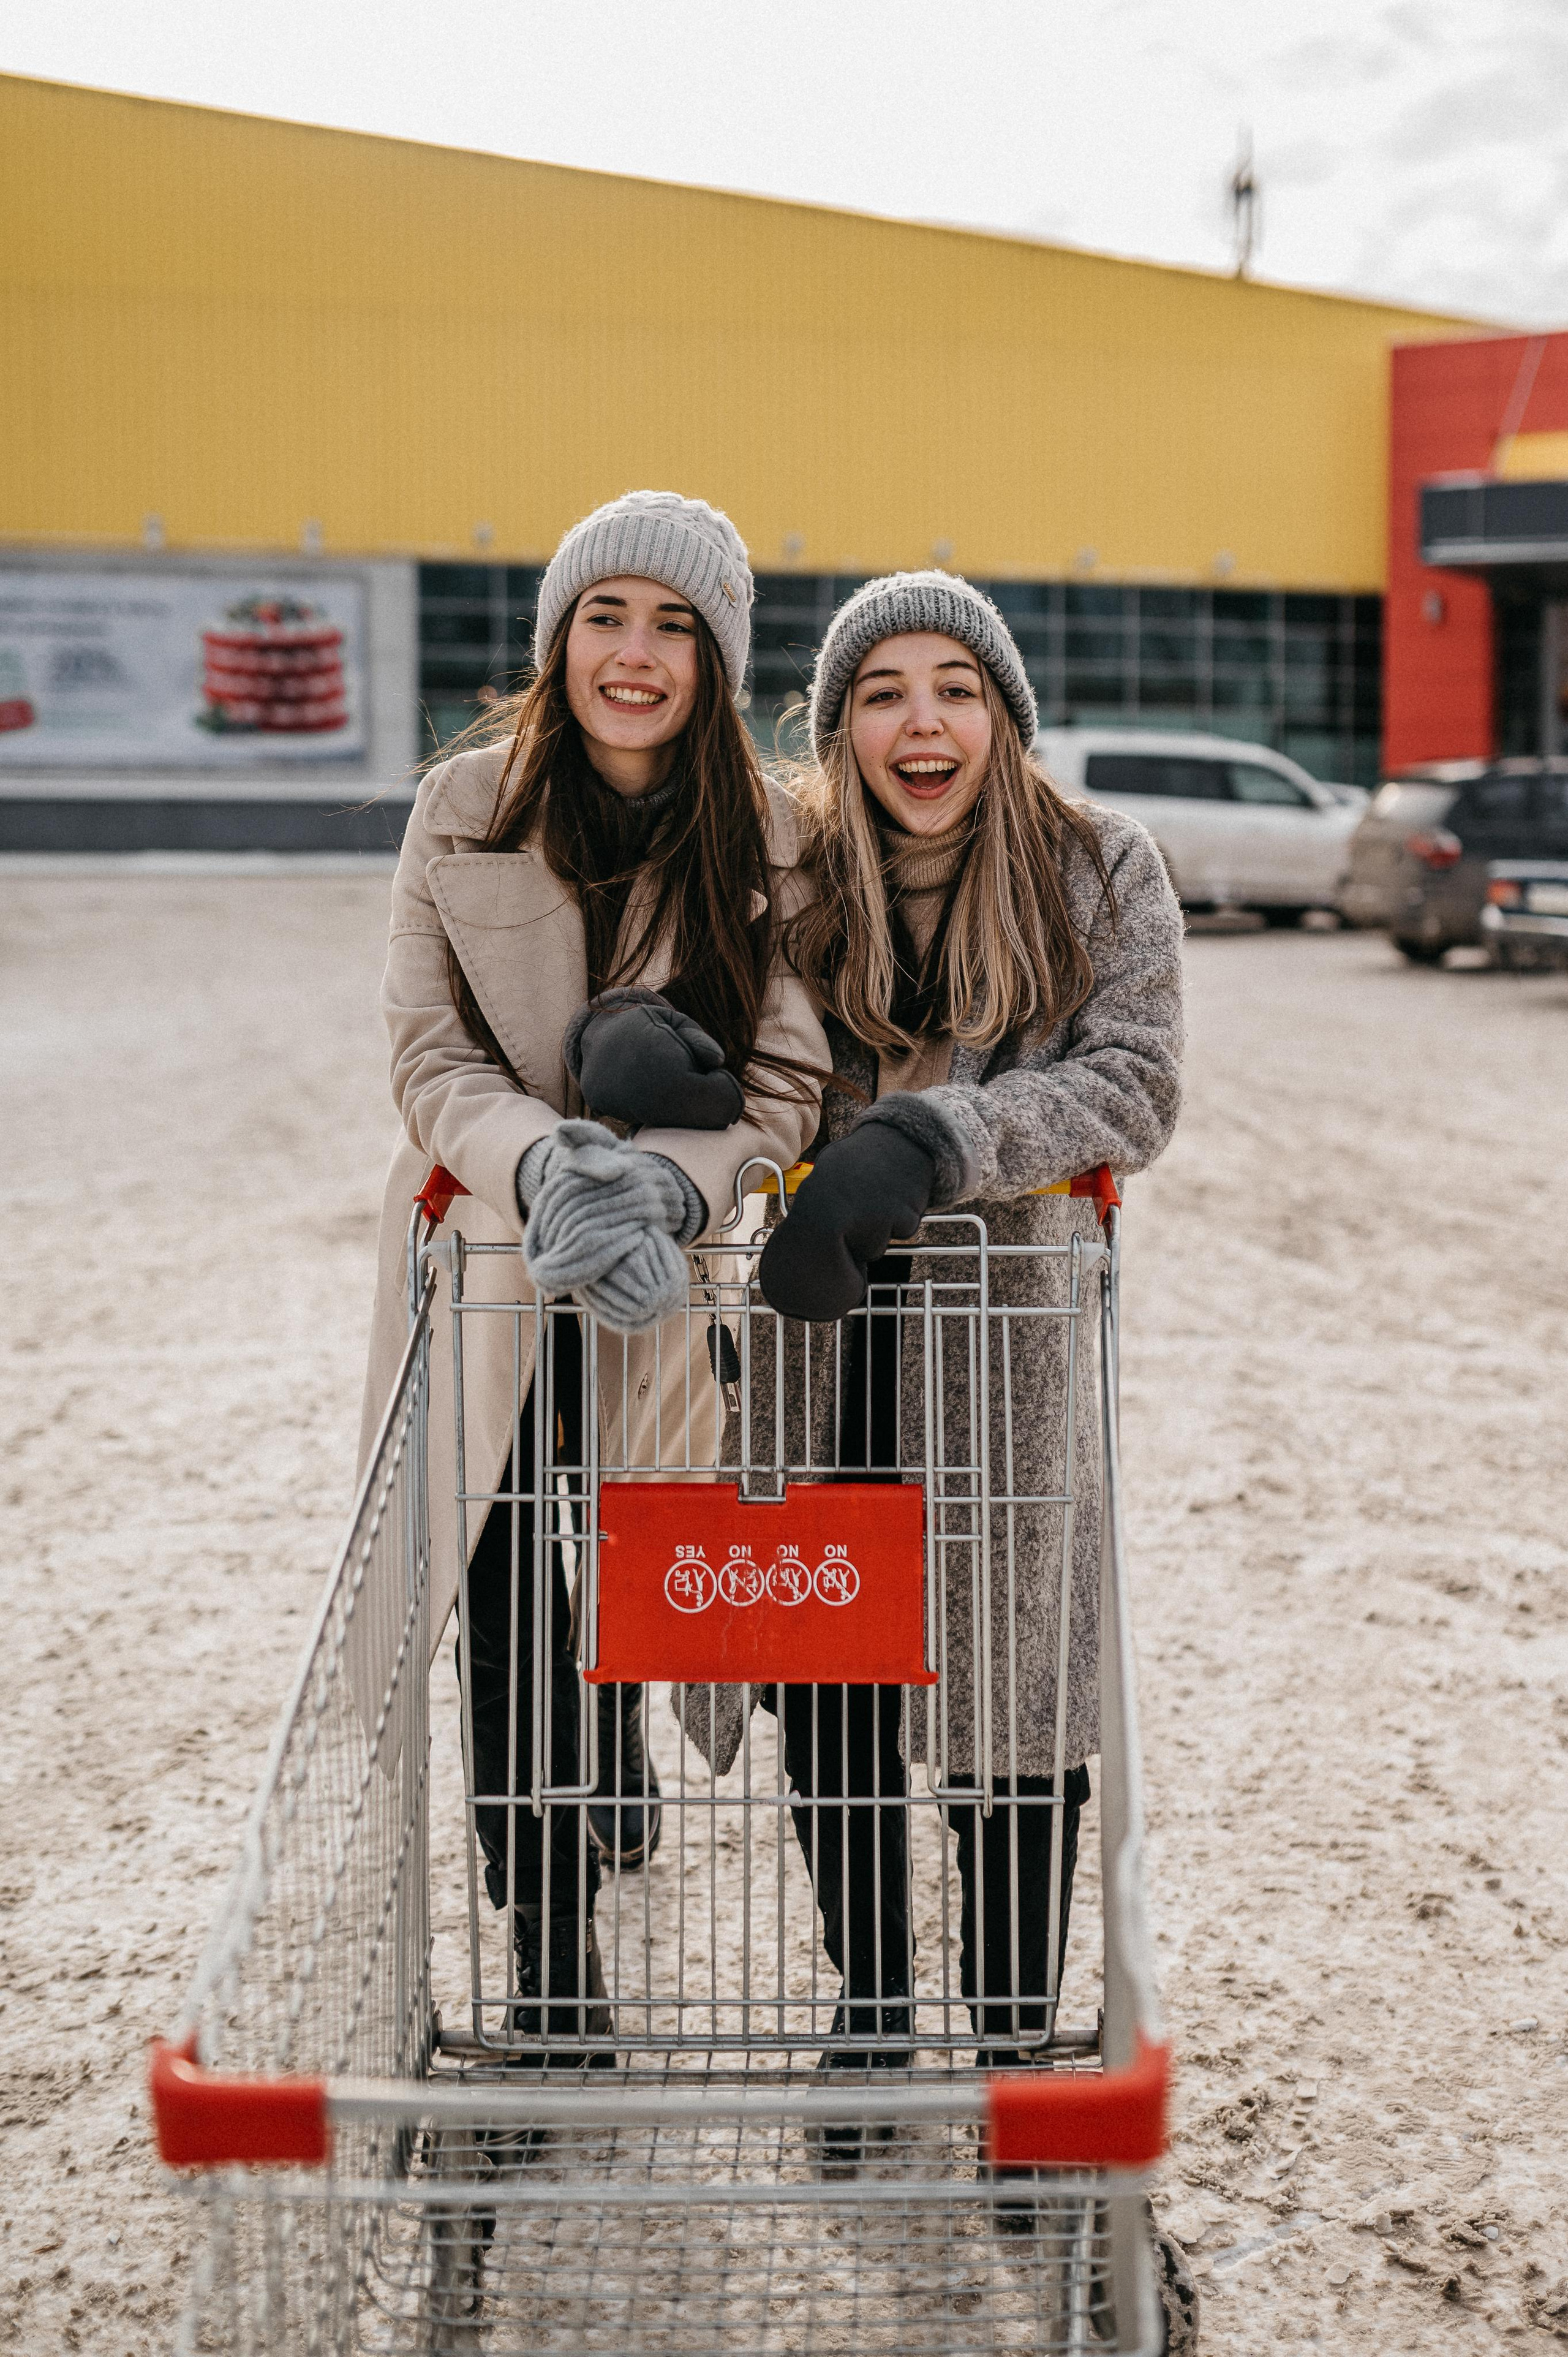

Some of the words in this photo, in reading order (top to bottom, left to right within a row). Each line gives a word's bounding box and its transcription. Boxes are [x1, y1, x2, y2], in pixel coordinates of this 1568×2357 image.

[675, 1545, 706, 1558] YES
[729, 1545, 752, 1558] NO
[824, 1545, 847, 1557] NO
